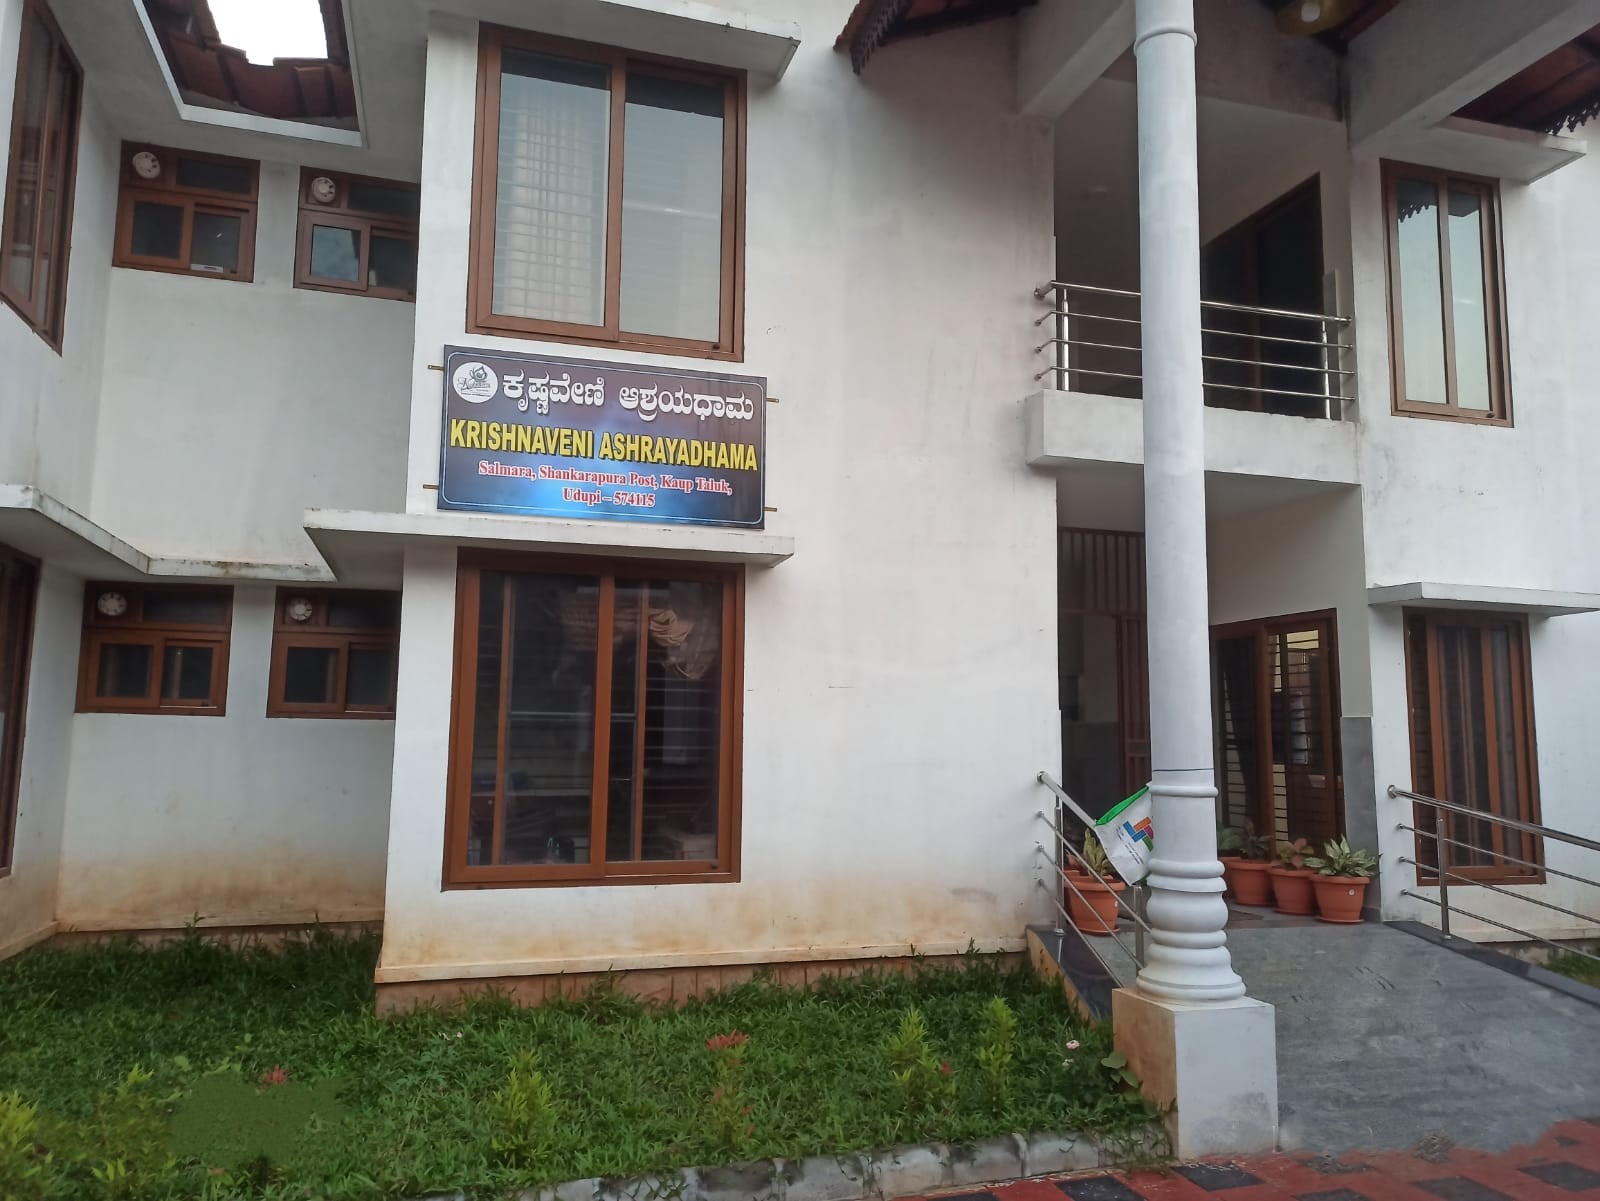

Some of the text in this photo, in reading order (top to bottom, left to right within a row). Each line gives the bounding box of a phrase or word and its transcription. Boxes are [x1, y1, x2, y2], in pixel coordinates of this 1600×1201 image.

[619, 383, 754, 422] ಆಶ್ರಯಧಾಮ
[450, 418, 758, 471] KRISHNAVENI ASHRAYADHAMA
[479, 461, 733, 496] Salmara, Shankarapura Post, Kaup Taluk,
[562, 487, 602, 507] Udupi
[613, 491, 656, 508] 574115
